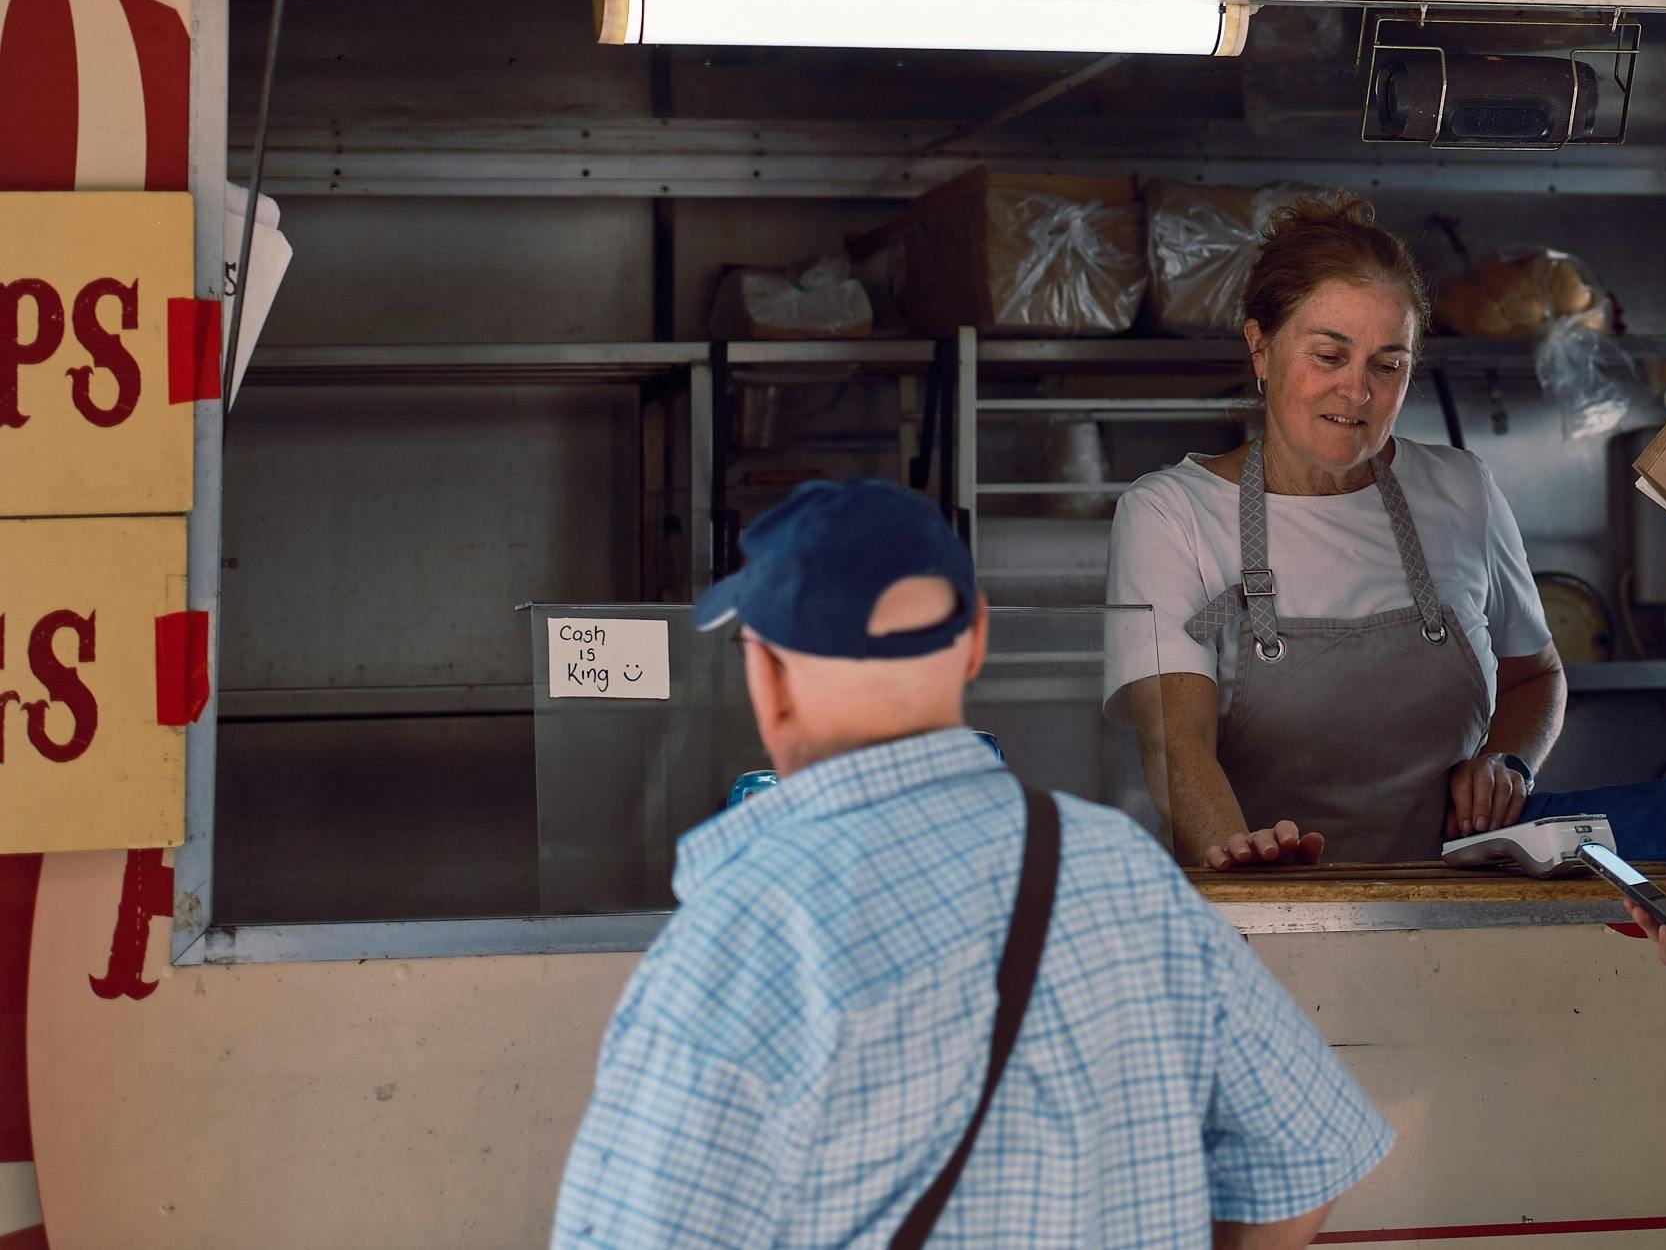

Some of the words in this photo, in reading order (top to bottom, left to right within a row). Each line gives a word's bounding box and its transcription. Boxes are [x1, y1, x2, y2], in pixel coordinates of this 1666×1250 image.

[560, 625, 605, 645] Cash
[580, 648, 596, 662] is
[568, 663, 608, 692] King
